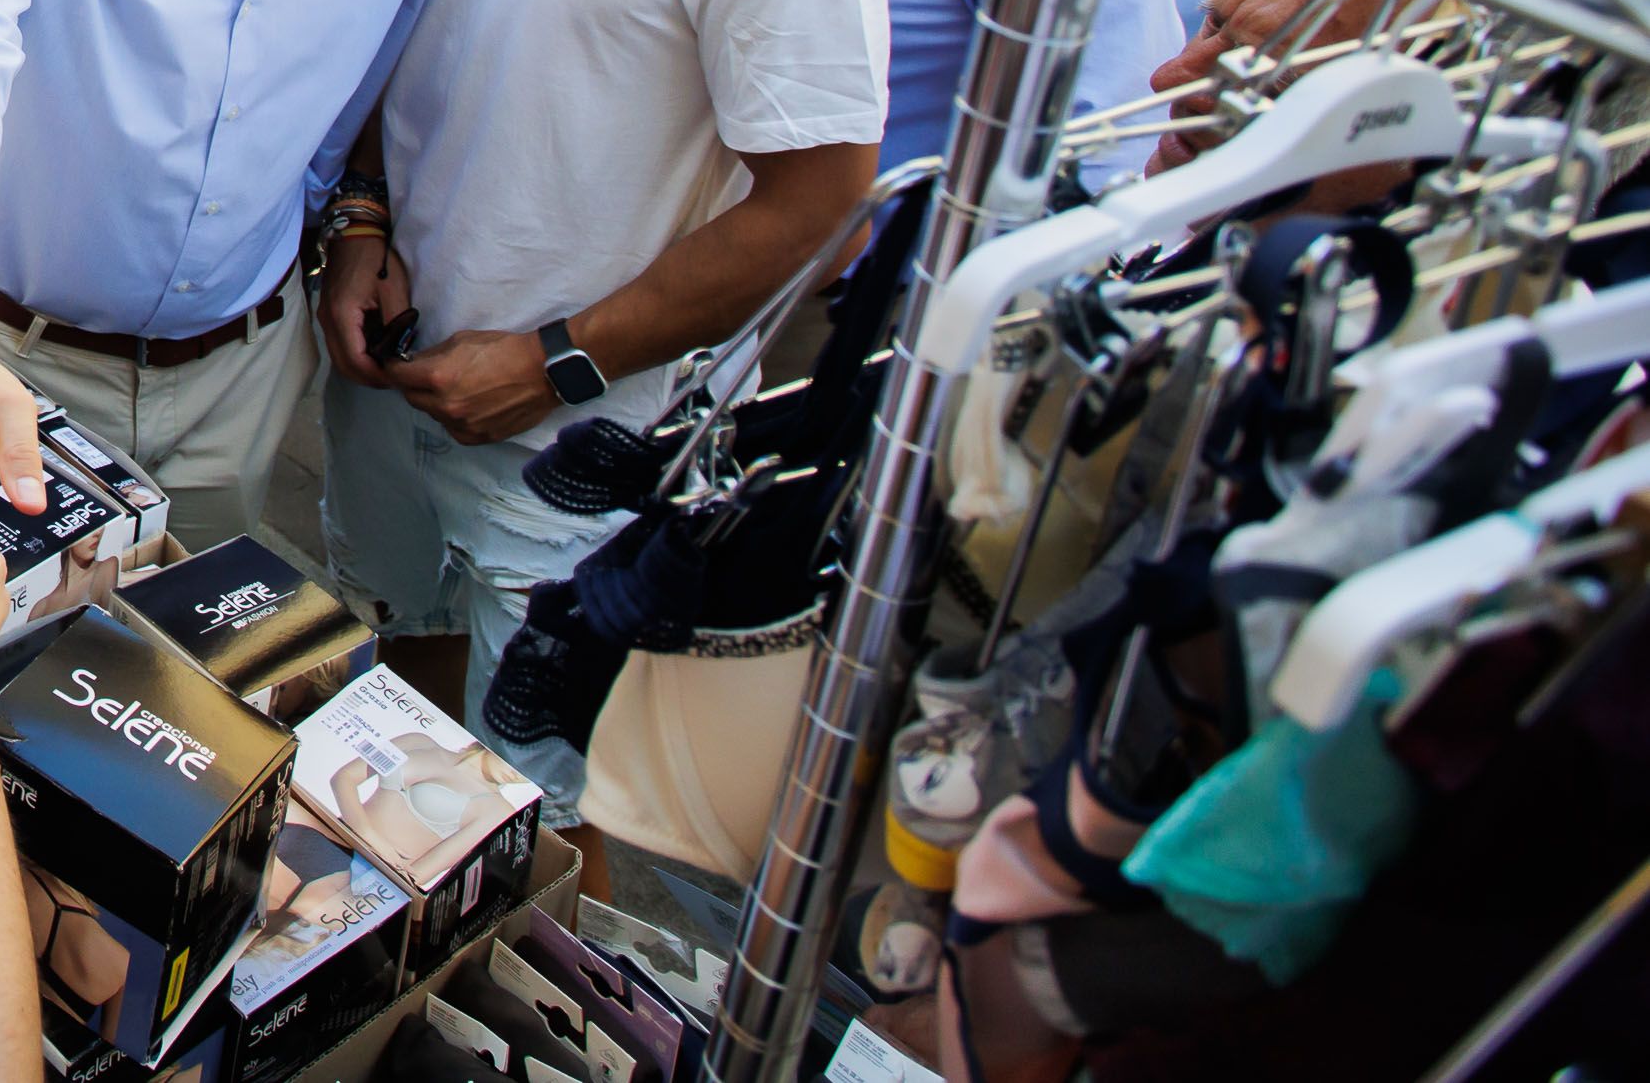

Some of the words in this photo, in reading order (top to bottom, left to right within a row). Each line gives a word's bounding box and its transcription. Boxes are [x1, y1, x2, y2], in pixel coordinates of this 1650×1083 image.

[195, 584, 278, 625] Selene
[52, 668, 214, 782] Selene
[358, 685, 388, 711] Grazia
[367, 673, 434, 730] Selene
[140, 709, 217, 761] creaciones
[268, 761, 294, 842] Selene
[320, 883, 397, 937] Selene
[231, 973, 260, 997] ely
[247, 992, 308, 1048] Selene
